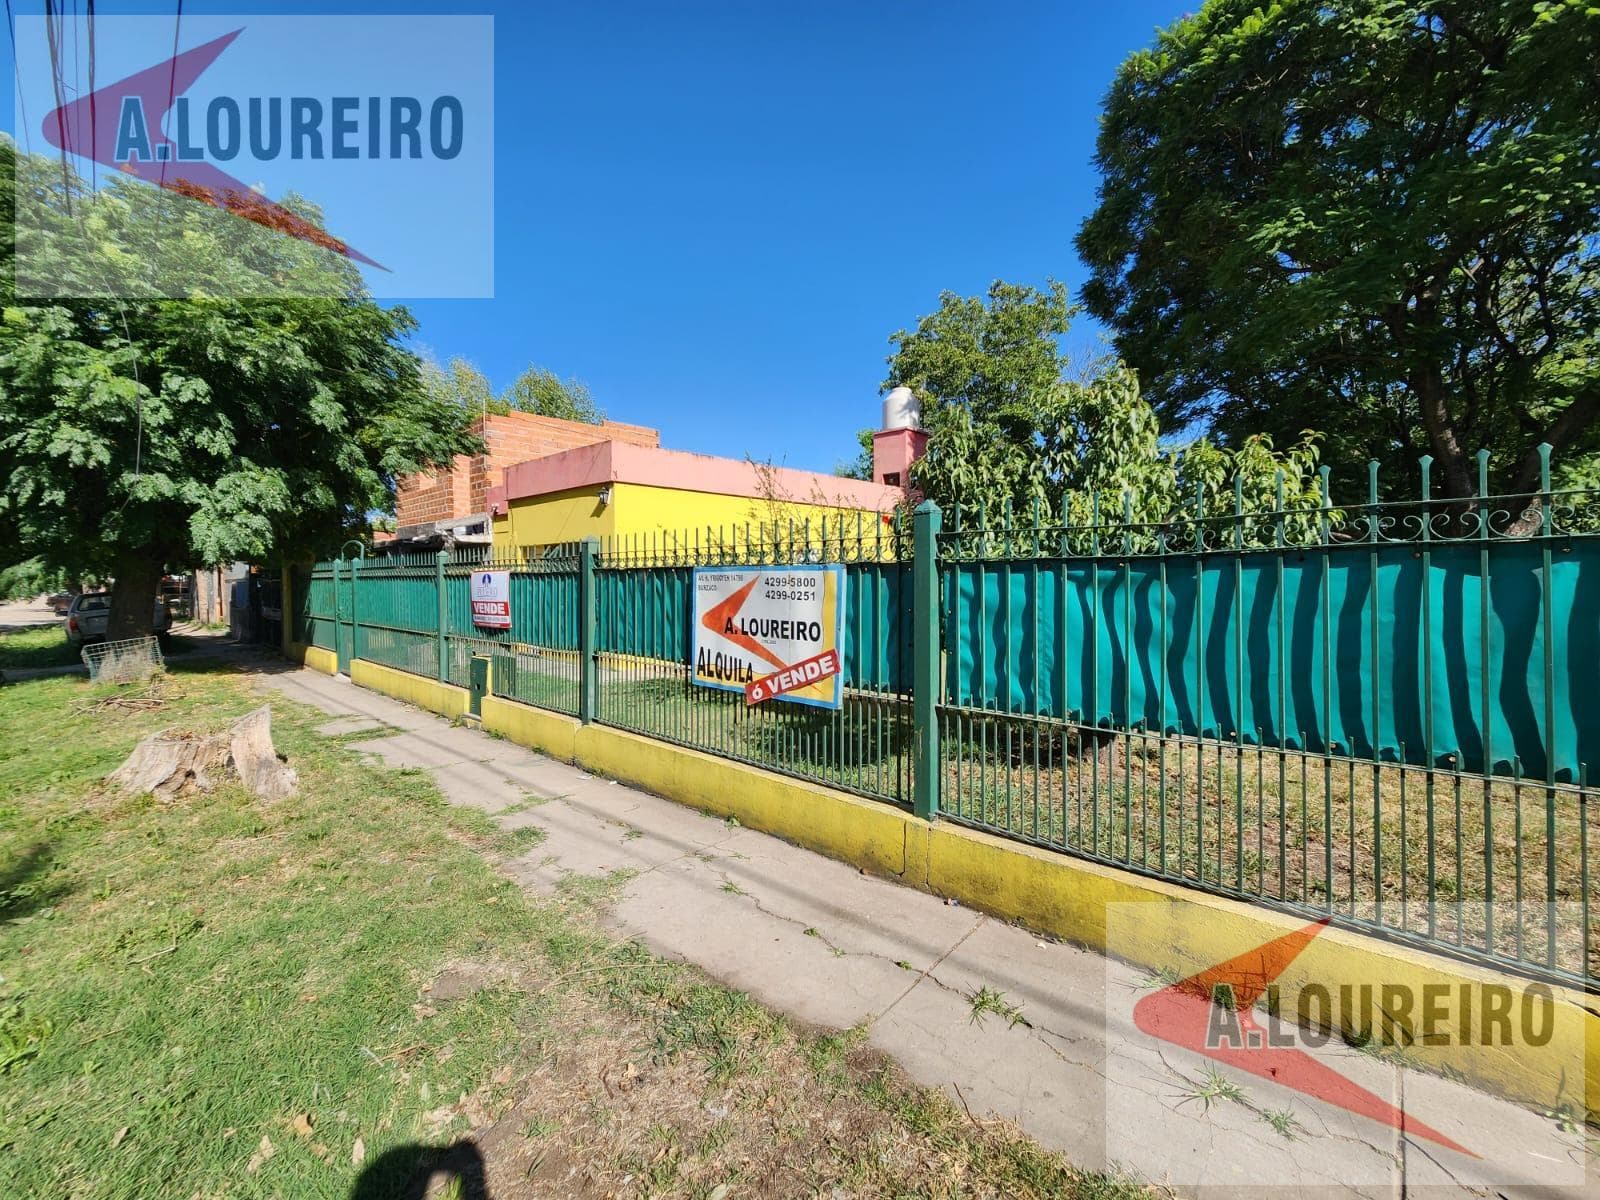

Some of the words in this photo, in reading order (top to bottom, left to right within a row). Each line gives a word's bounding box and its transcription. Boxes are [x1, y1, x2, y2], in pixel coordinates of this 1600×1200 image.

[764, 577, 816, 588] 4299-5800
[764, 590, 816, 601] 4299-0251
[473, 602, 506, 614] VENDE
[741, 617, 821, 642] LOUREIRO
[696, 646, 753, 684] ALQUILA
[766, 655, 836, 694] VENDE
